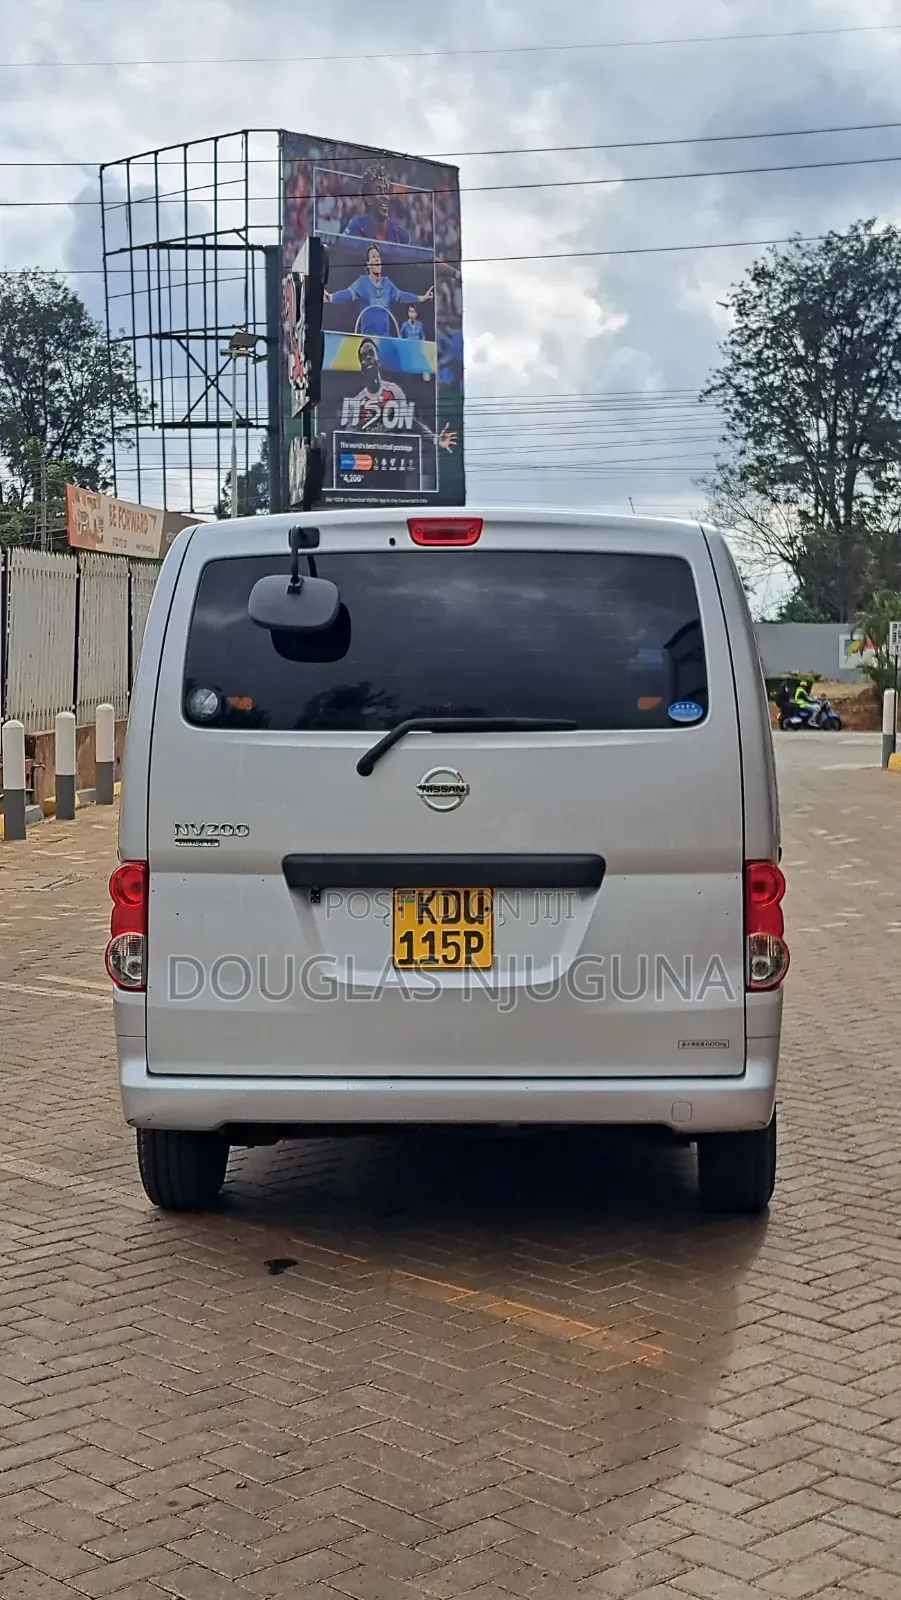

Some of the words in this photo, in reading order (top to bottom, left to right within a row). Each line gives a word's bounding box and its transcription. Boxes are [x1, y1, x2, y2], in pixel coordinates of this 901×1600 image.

[382, 400, 414, 429] ON
[350, 442, 366, 450] world's
[108, 503, 117, 528] BE
[118, 506, 149, 535] FORWARD
[420, 784, 466, 793] NISSAN
[174, 822, 250, 837] NV200
[417, 889, 484, 925] KDU
[398, 930, 484, 965] 115P
